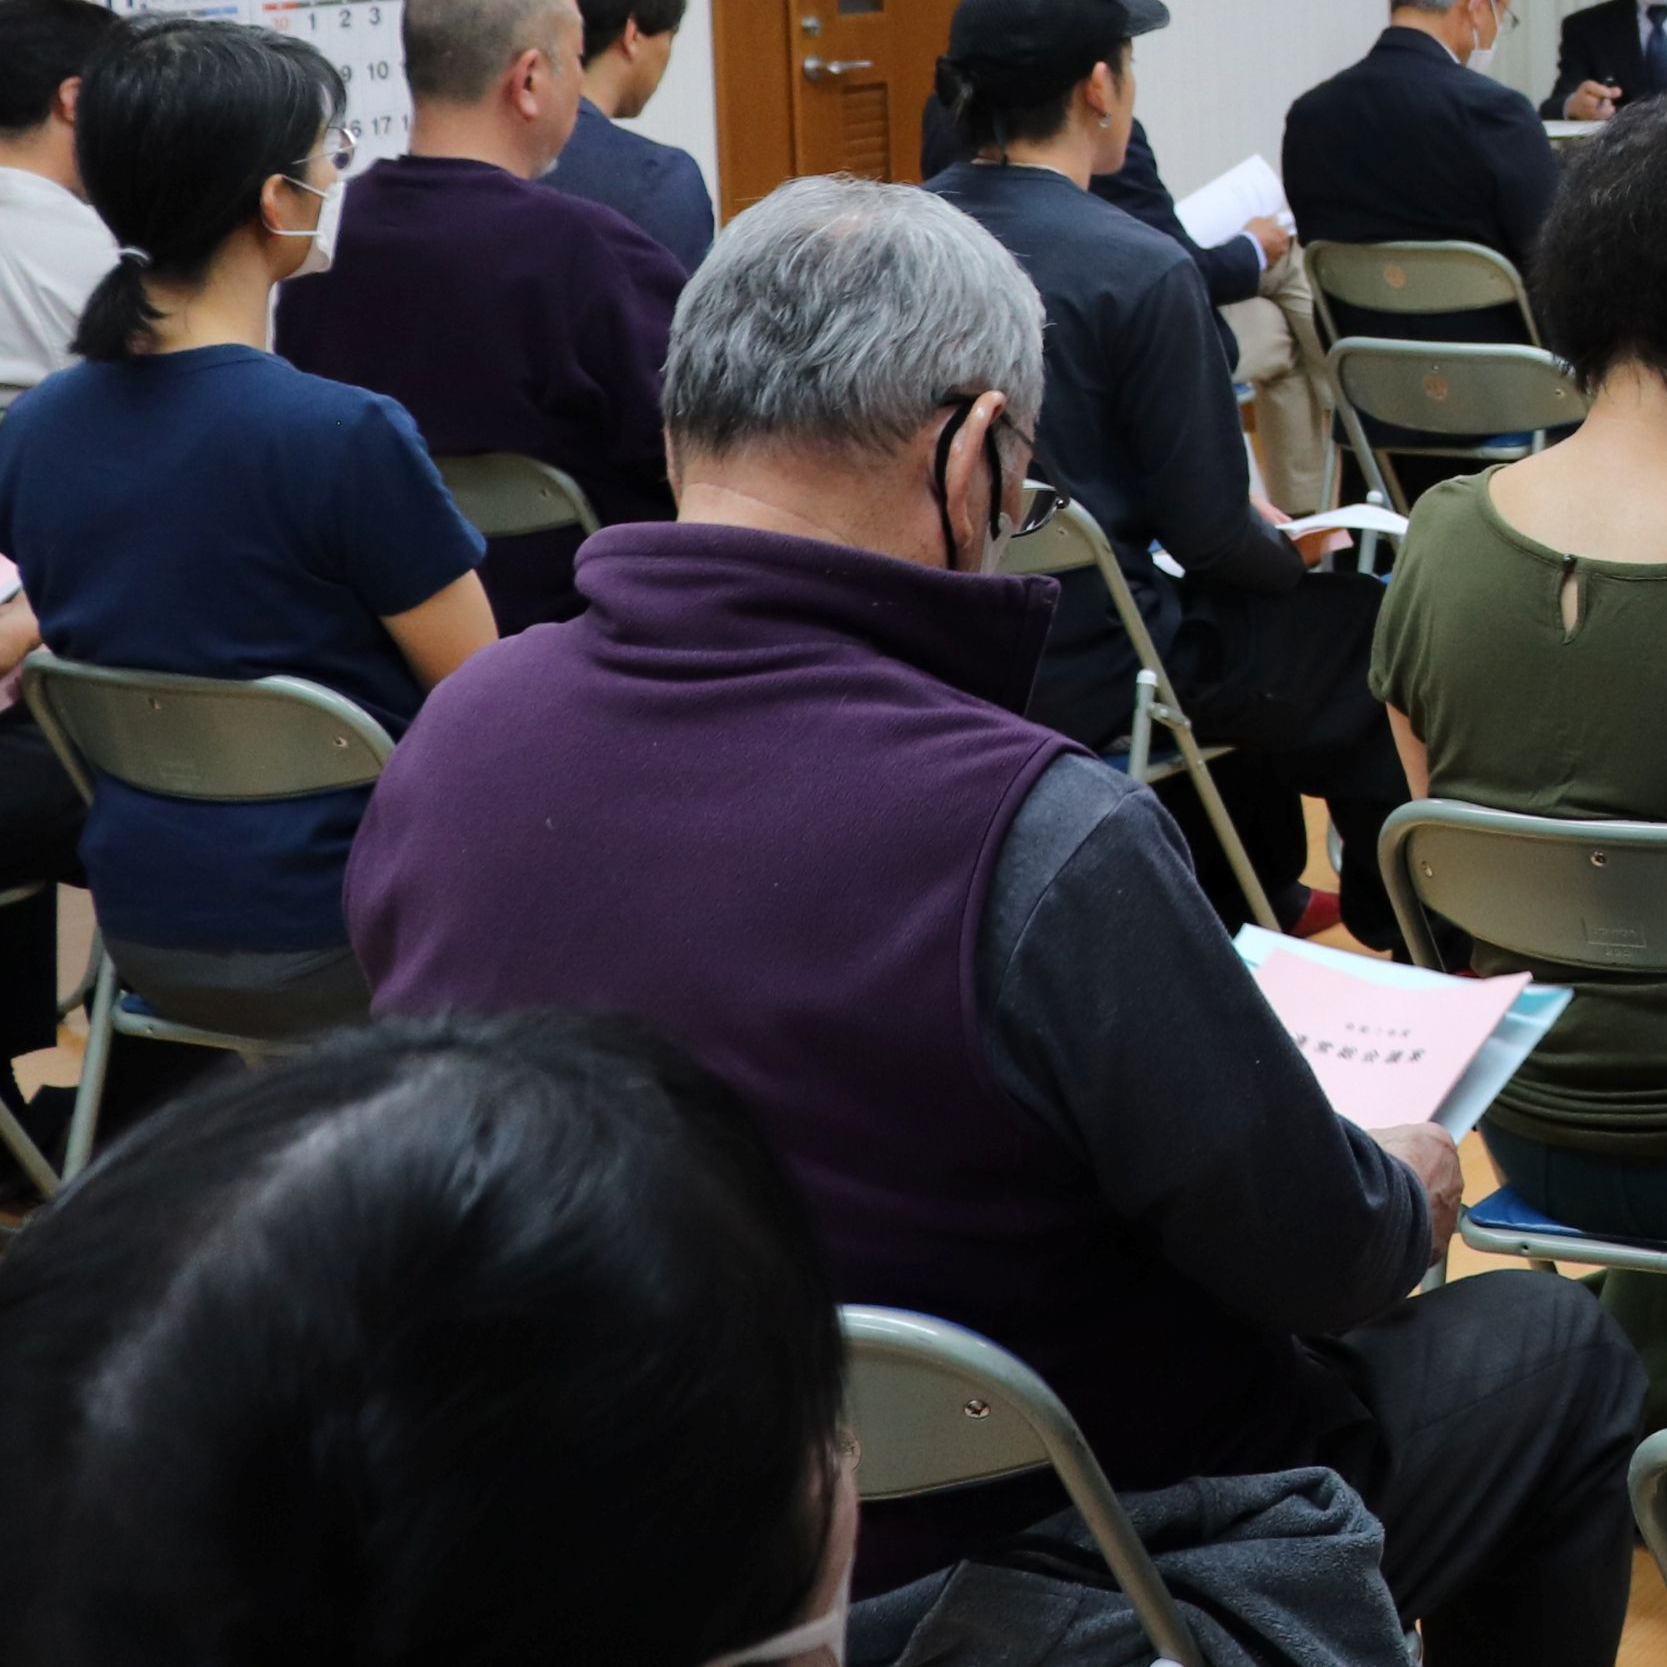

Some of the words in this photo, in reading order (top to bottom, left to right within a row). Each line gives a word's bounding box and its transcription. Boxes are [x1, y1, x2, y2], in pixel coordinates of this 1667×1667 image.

[309, 12, 318, 31] 1
[339, 8, 352, 29] 2
[369, 6, 382, 26] 3
[341, 65, 353, 83] 9
[367, 60, 390, 80] 10
[371, 115, 392, 136] 17
